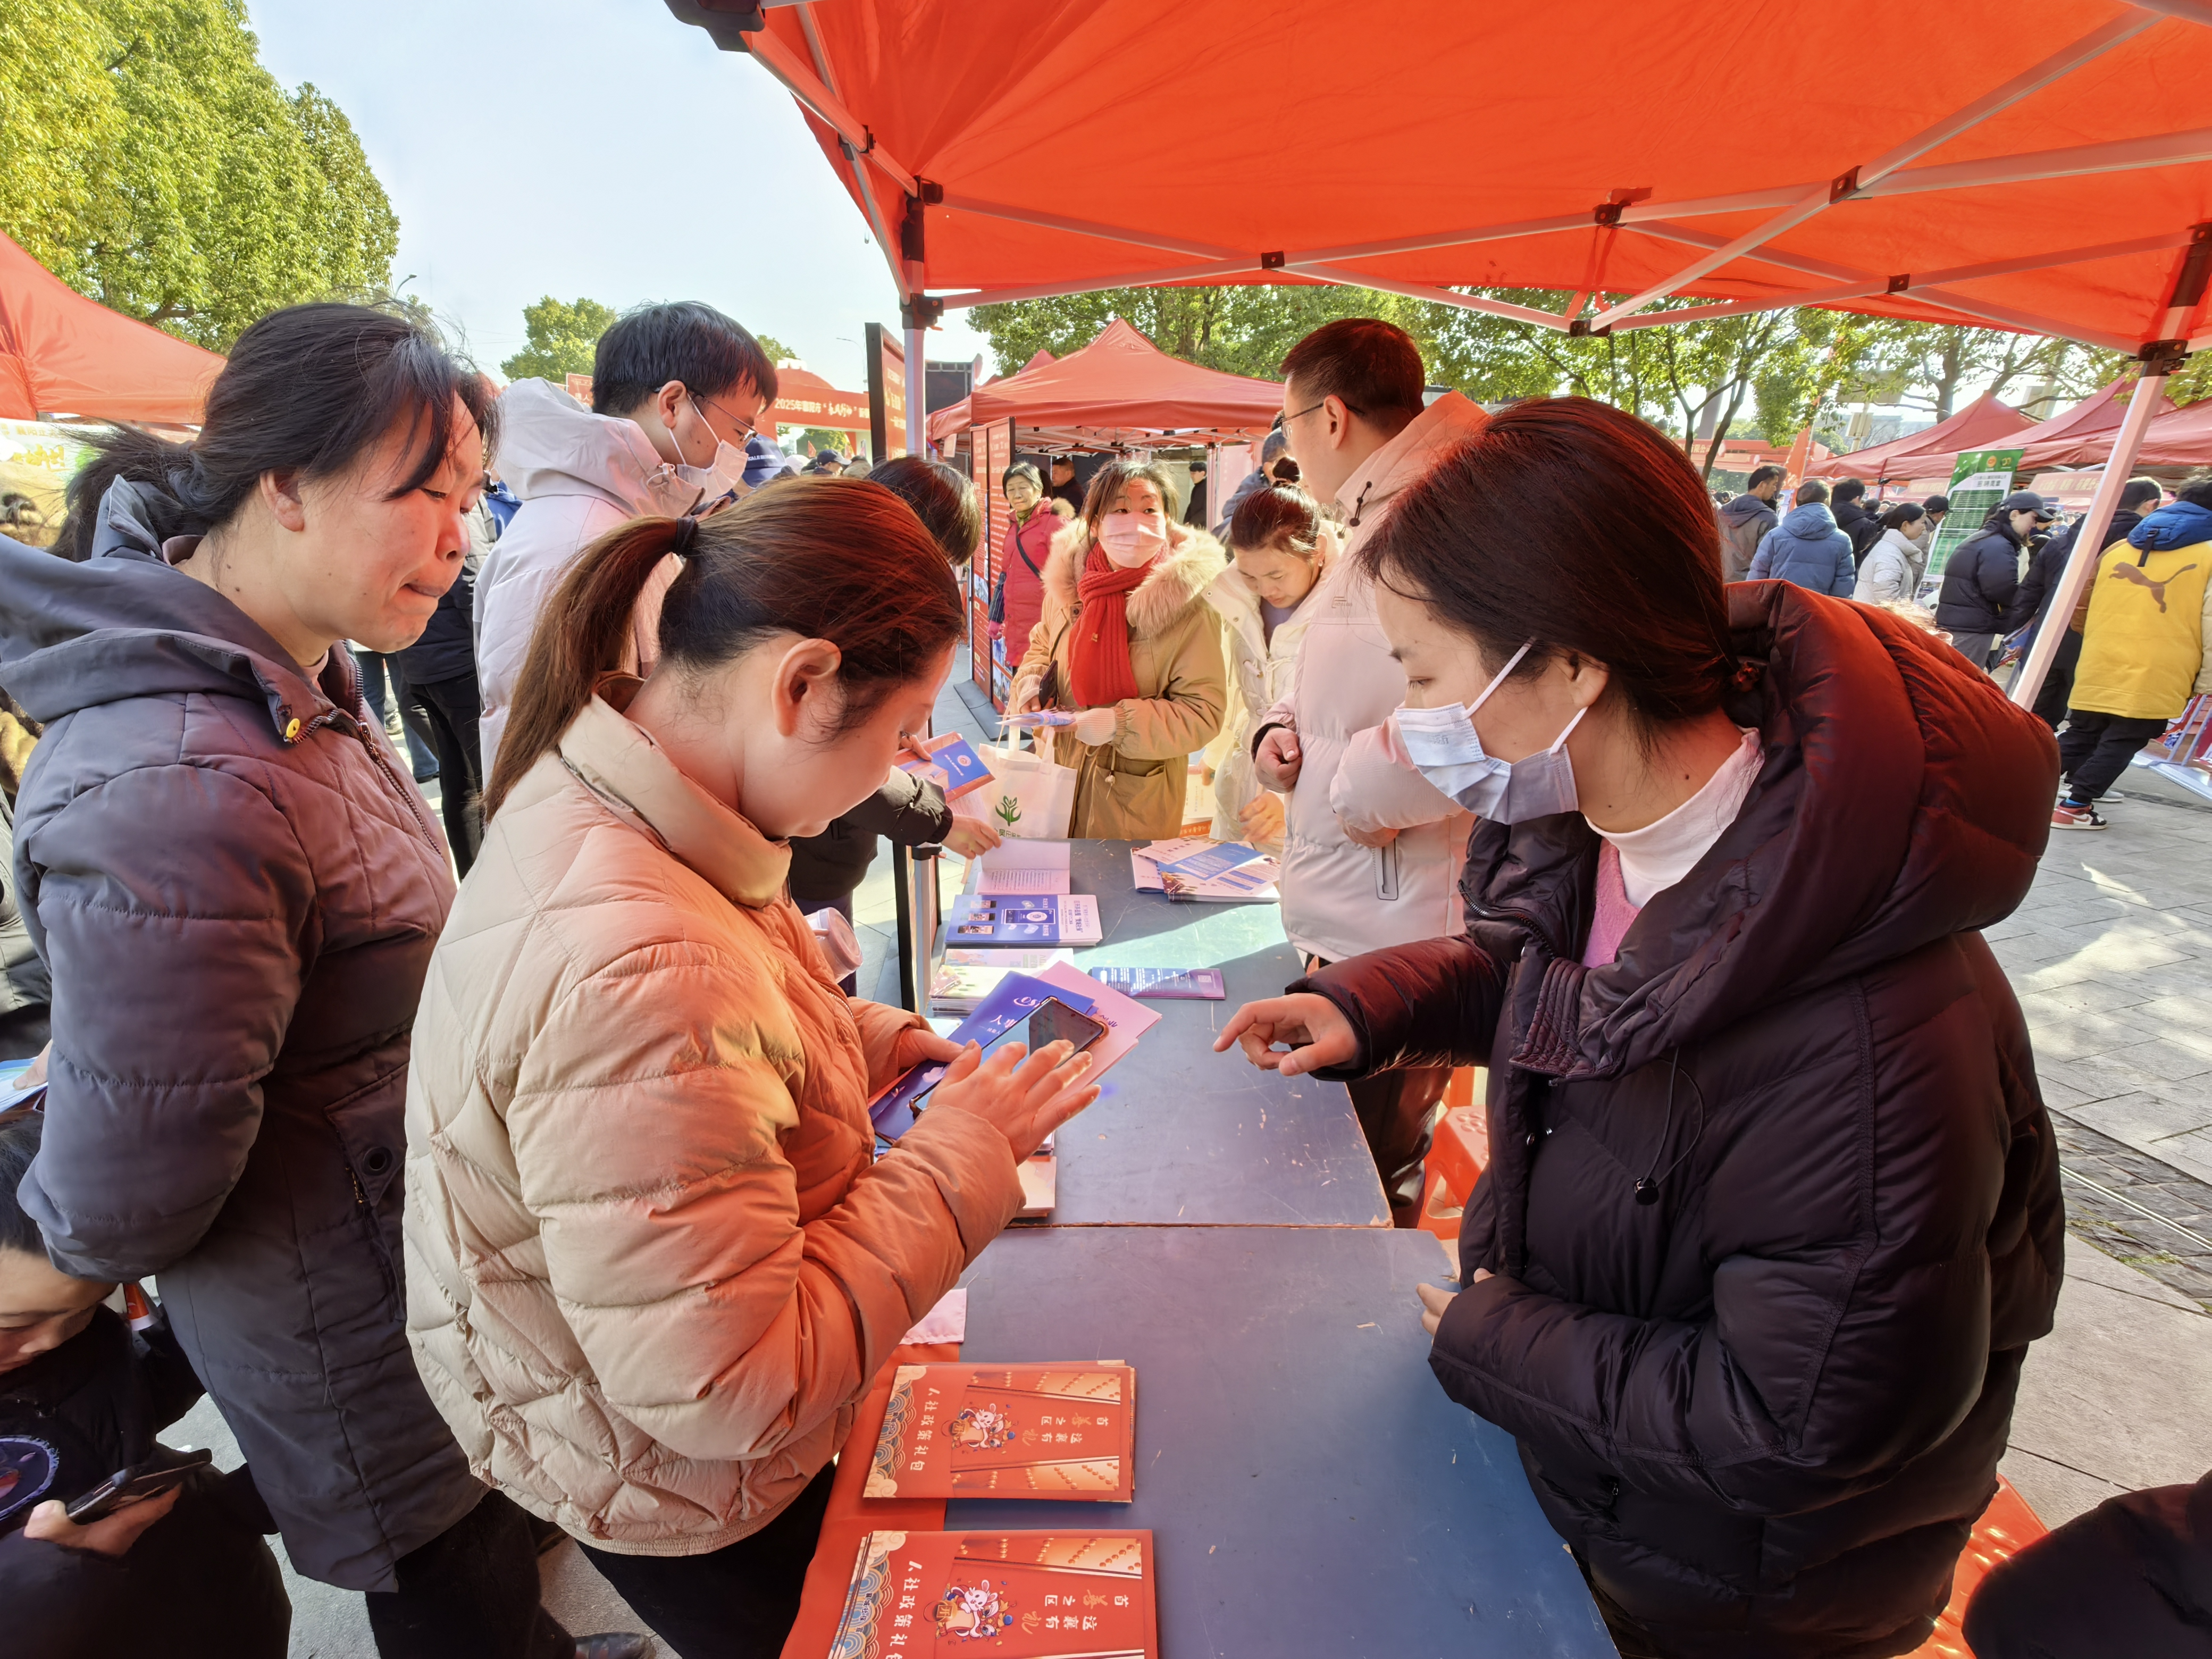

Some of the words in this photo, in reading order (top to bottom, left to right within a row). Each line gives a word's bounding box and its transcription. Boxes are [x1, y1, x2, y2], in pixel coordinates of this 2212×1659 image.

[910, 1387, 940, 1470] 人社政策礼包
[1041, 1412, 1109, 1428] 首善之区
[1022, 1428, 1083, 1446] 这襄有礼
[1045, 1589, 1129, 1610] 首善之区
[1021, 1611, 1097, 1635] 这襄有礼
